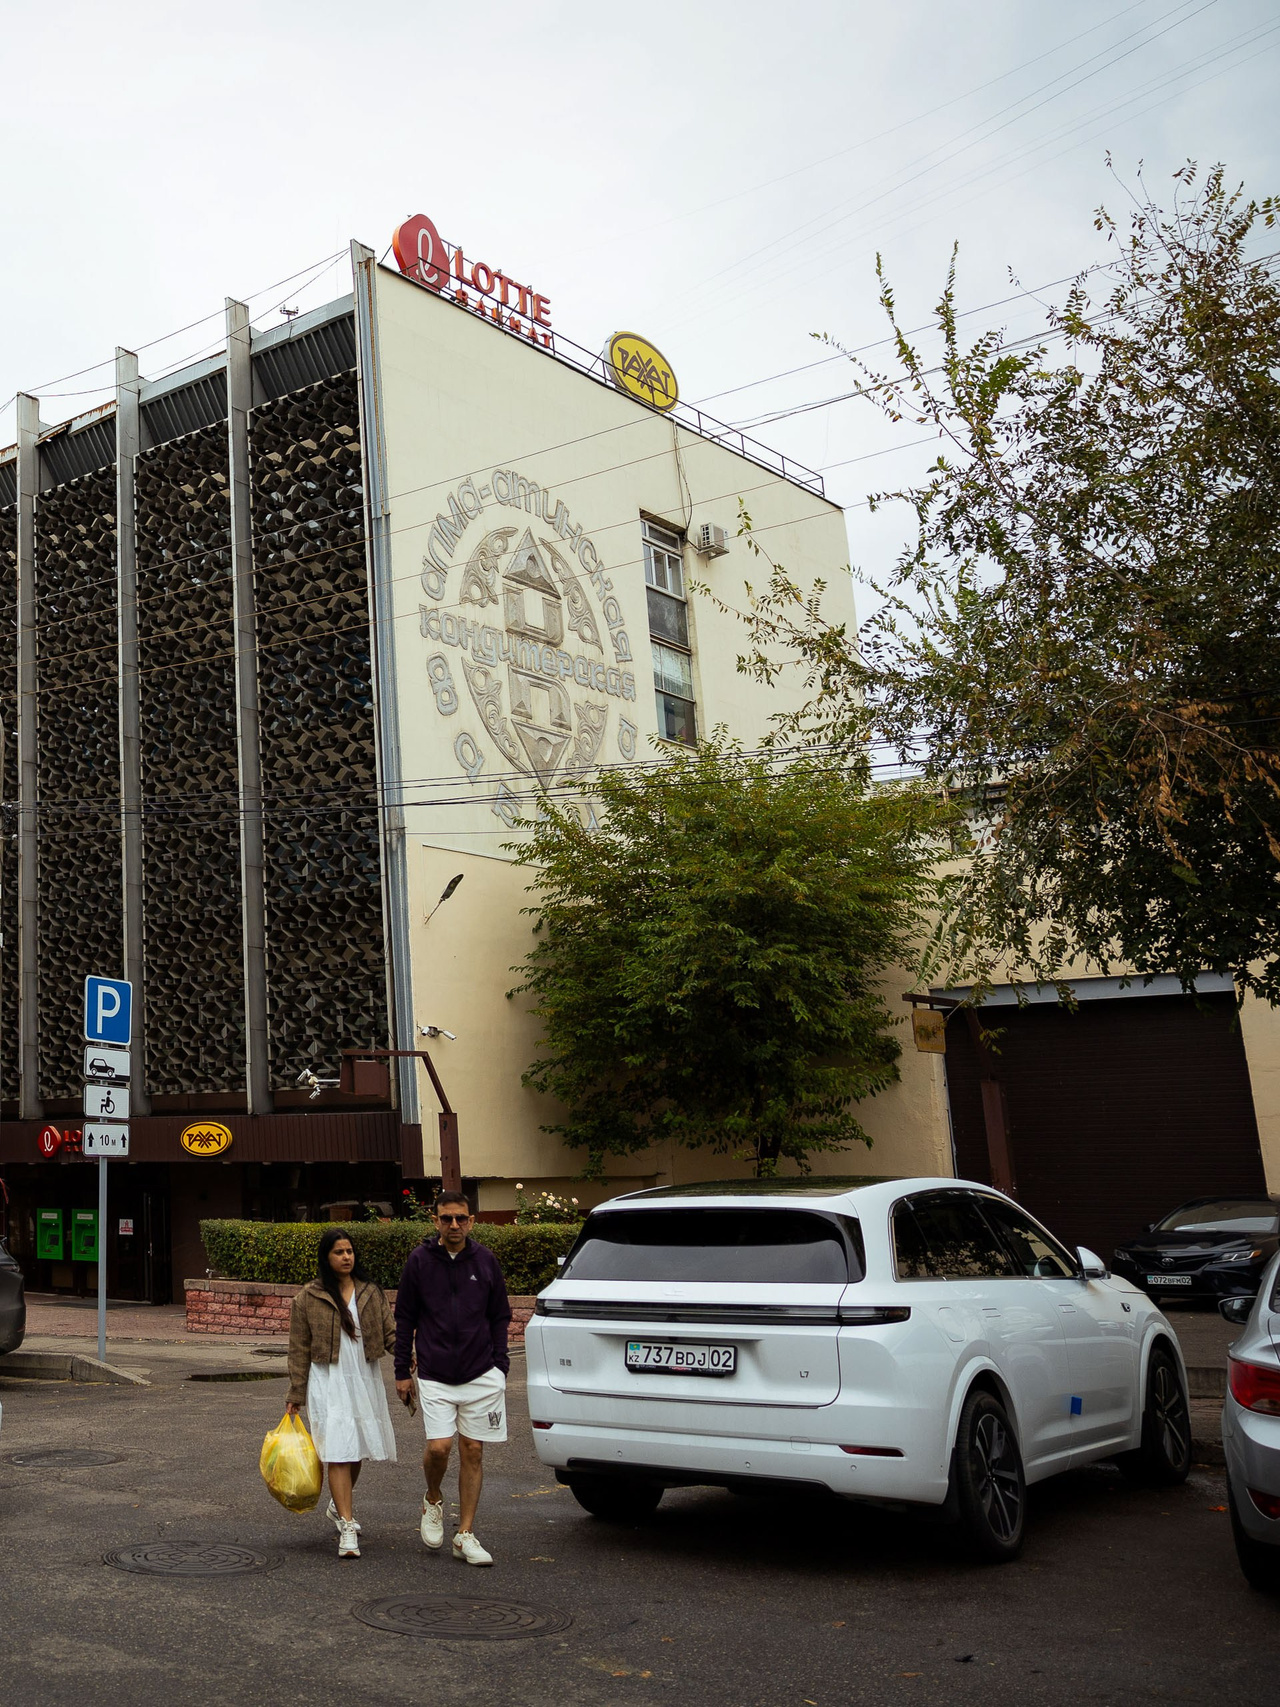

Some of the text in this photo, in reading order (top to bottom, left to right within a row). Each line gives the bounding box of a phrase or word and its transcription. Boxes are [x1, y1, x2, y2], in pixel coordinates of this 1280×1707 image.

[455, 250, 552, 327] LOTTE
[97, 985, 121, 1034] P
[99, 1135, 109, 1146] 10
[628, 1355, 639, 1363] KZ
[800, 1370, 809, 1378] L7
